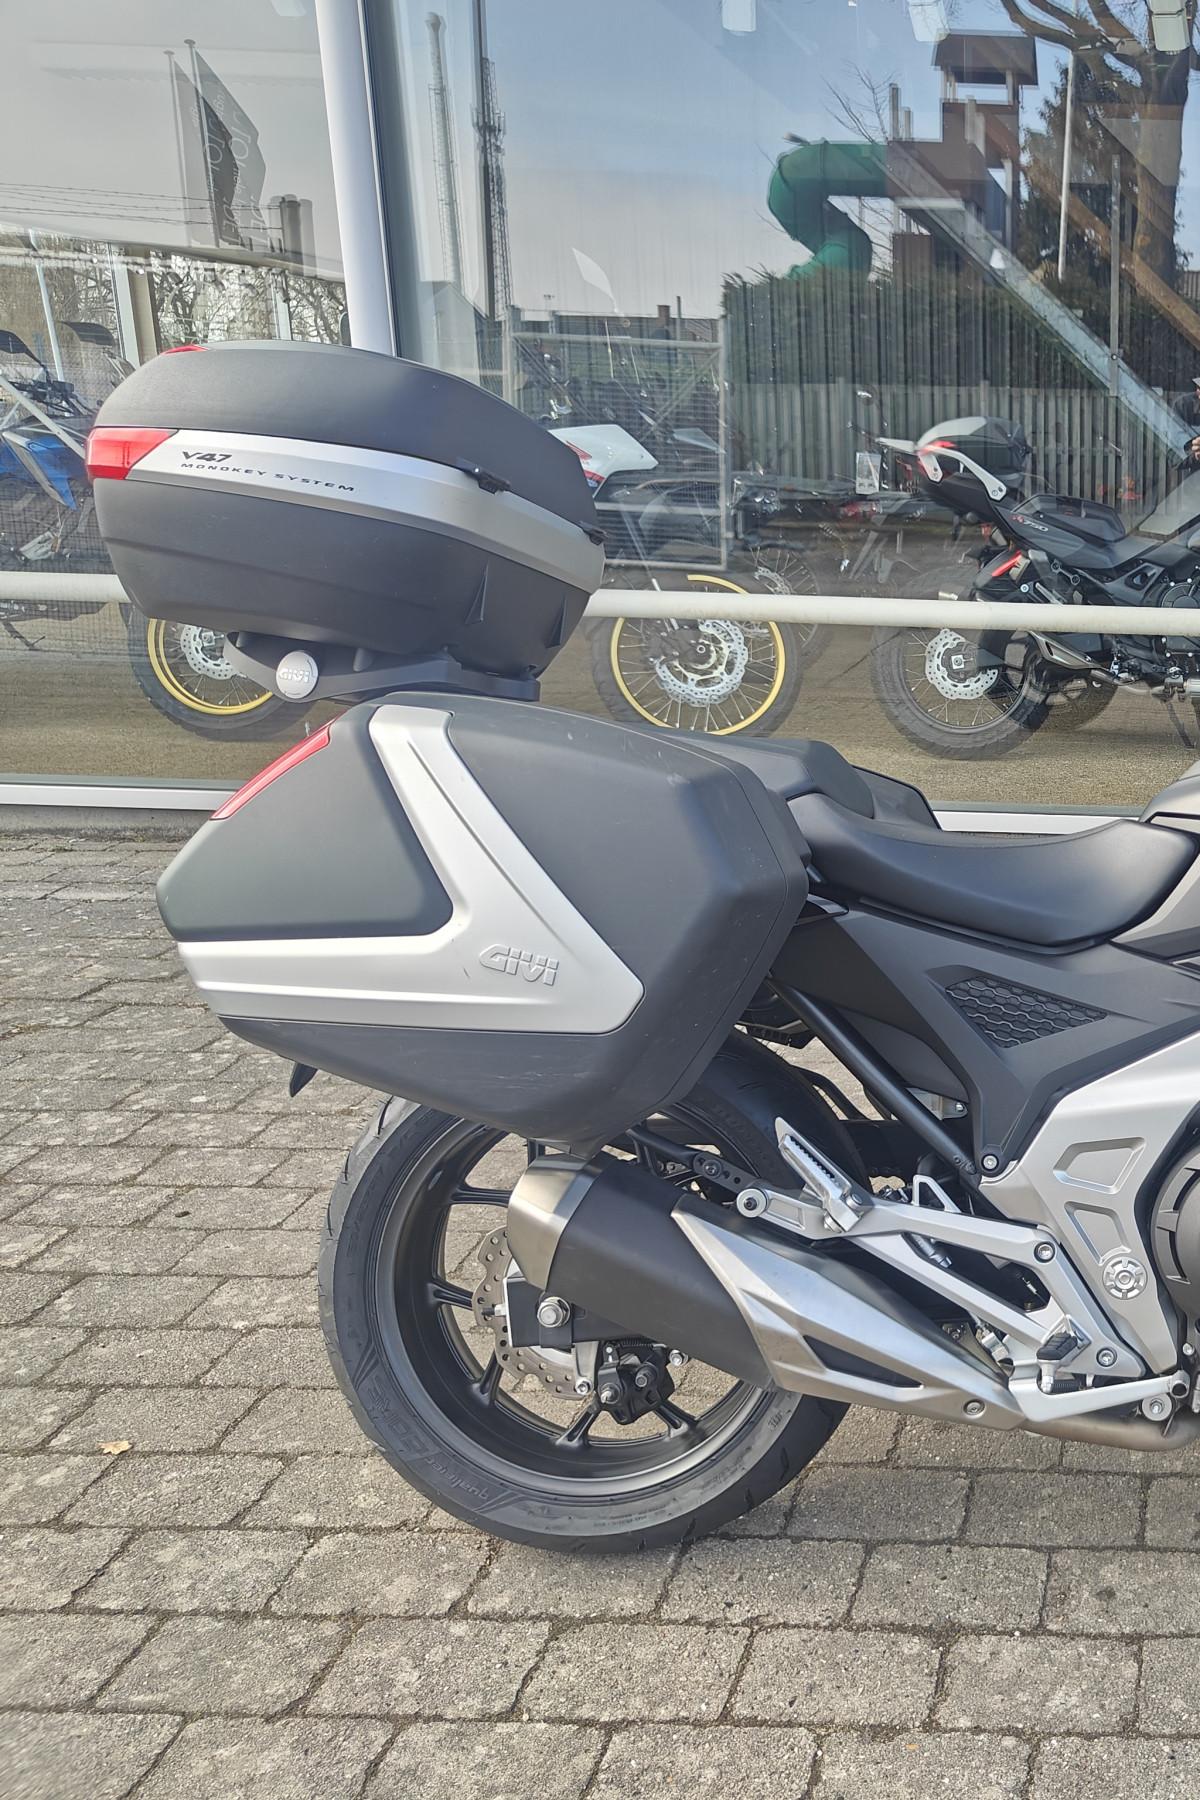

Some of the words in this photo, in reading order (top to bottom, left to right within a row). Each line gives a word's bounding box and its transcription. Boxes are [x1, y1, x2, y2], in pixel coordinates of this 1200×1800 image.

[182, 451, 232, 463] V47
[180, 463, 267, 477] MONOKEY
[274, 473, 355, 492] SYSTEM
[479, 943, 560, 986] GIVI
